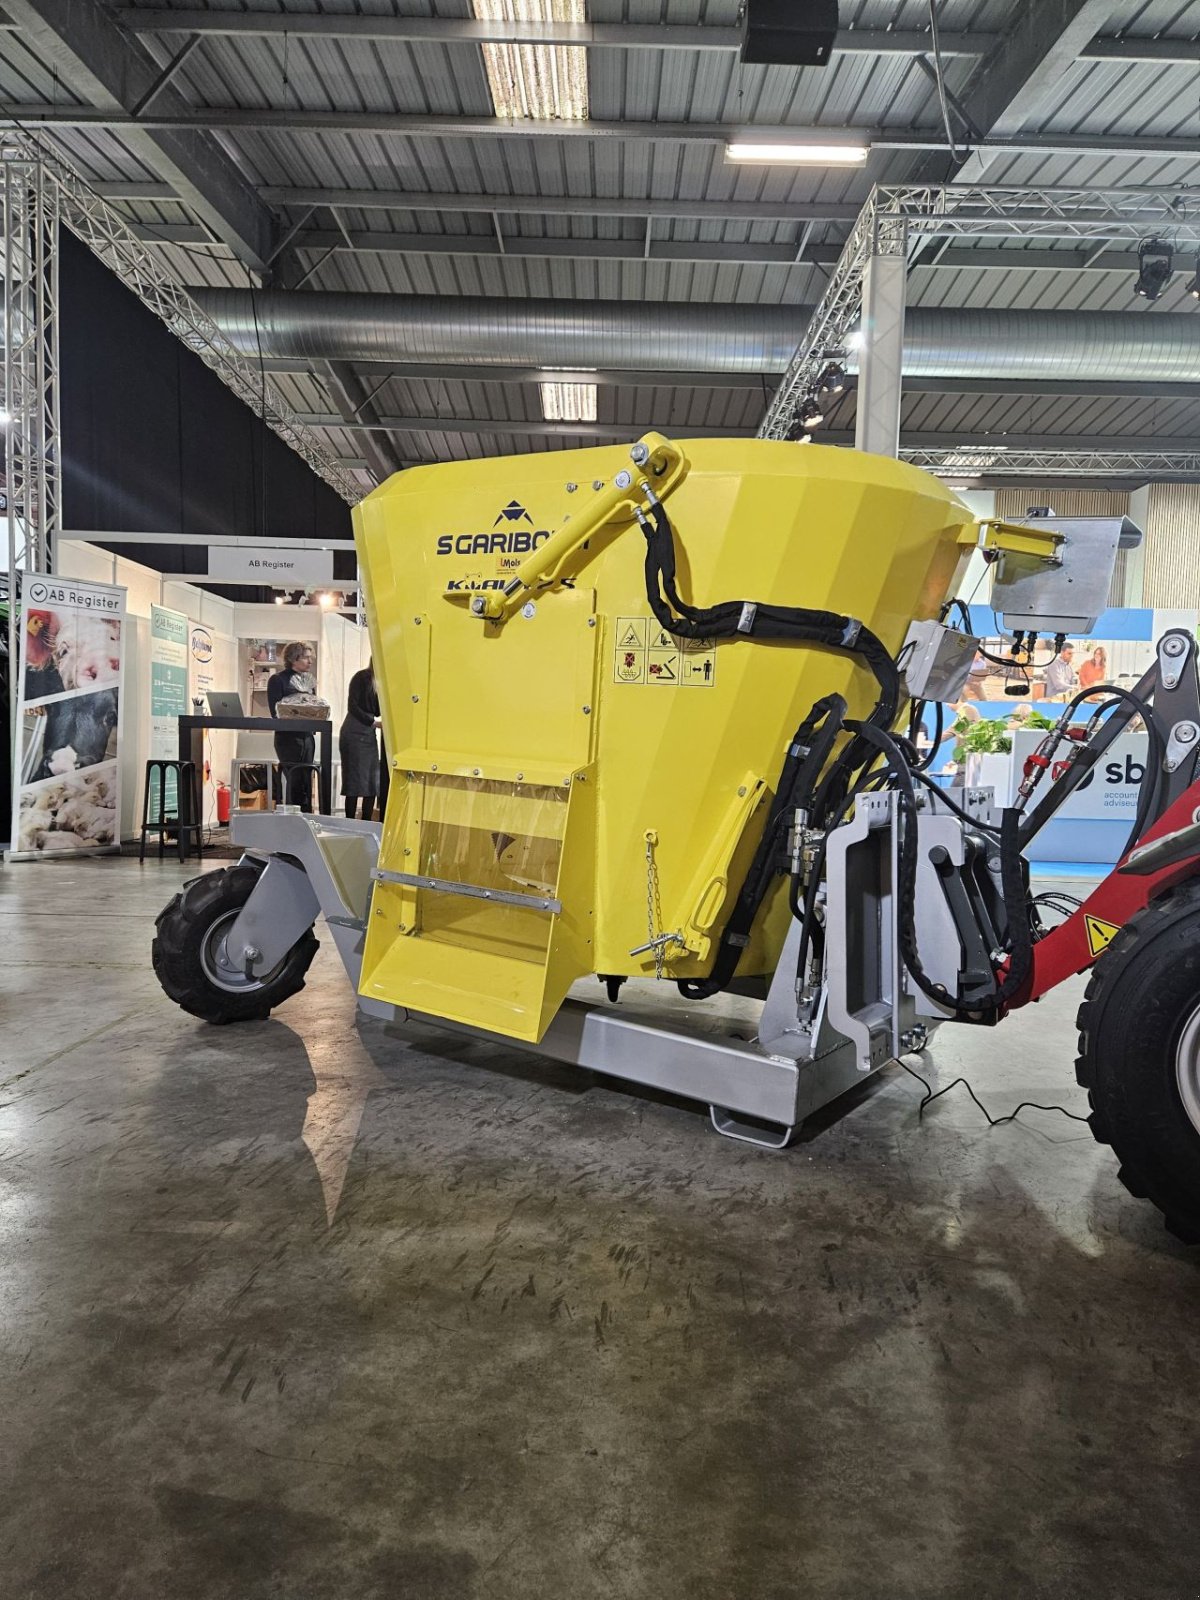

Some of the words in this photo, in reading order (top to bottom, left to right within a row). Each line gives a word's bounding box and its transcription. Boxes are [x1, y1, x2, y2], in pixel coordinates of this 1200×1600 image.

[248, 559, 261, 567] AB
[262, 560, 295, 570] Register
[49, 589, 65, 601] AB
[68, 592, 120, 609] Register
[1105, 754, 1146, 784] sb
